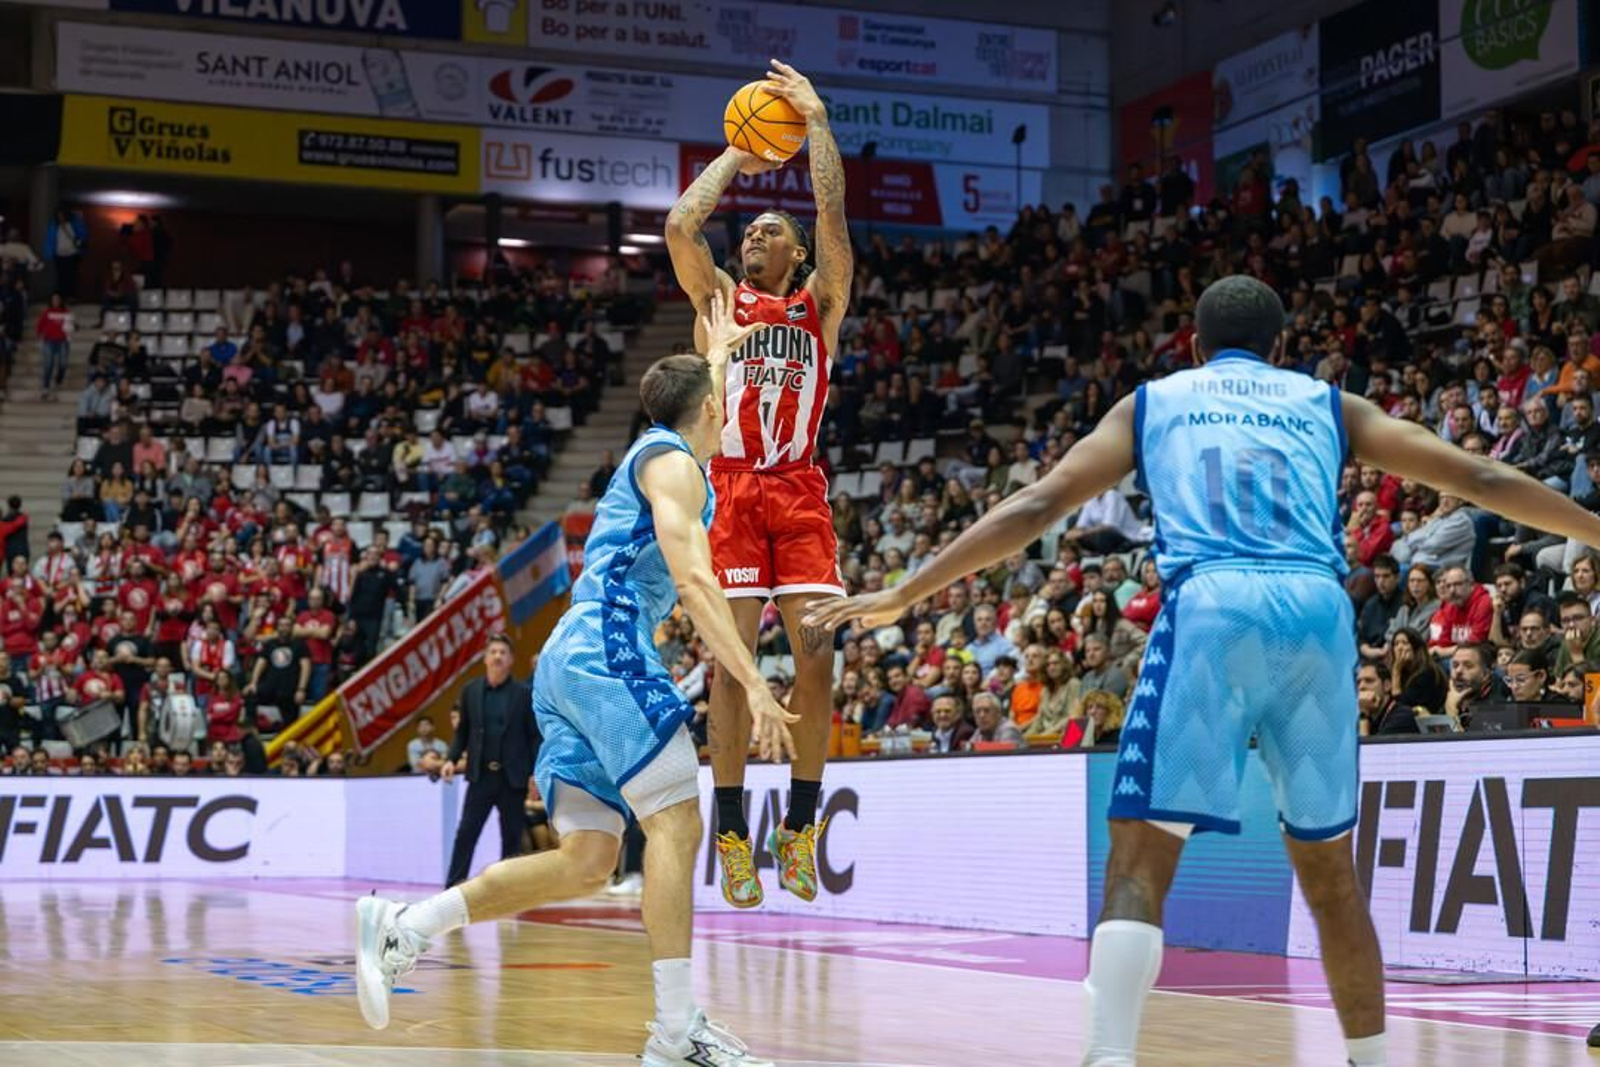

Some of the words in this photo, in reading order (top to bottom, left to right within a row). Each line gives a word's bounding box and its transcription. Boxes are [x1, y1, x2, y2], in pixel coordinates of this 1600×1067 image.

[614, 3, 628, 16] a
[541, 17, 568, 36] Bo
[575, 24, 608, 41] per
[615, 28, 628, 42] a
[632, 26, 651, 45] la
[657, 29, 711, 49] salut.
[195, 51, 269, 78] SANT
[273, 59, 360, 87] ANIOL
[858, 58, 937, 76] esportcat
[1359, 31, 1435, 88] PACER
[138, 118, 211, 139] Grues
[488, 104, 575, 126] VALENT
[892, 101, 994, 134] Dalmai
[139, 138, 231, 164] Viñolas
[538, 148, 671, 188] fustech
[963, 173, 980, 213] 5
[743, 366, 806, 390] FIATC
[1192, 378, 1288, 397] HARDING
[1188, 412, 1315, 435] MORABANC
[1198, 446, 1291, 541] 10
[724, 567, 760, 585] YOSOY
[347, 584, 504, 731] ENGAVIATS
[0, 794, 259, 863] FIATC
